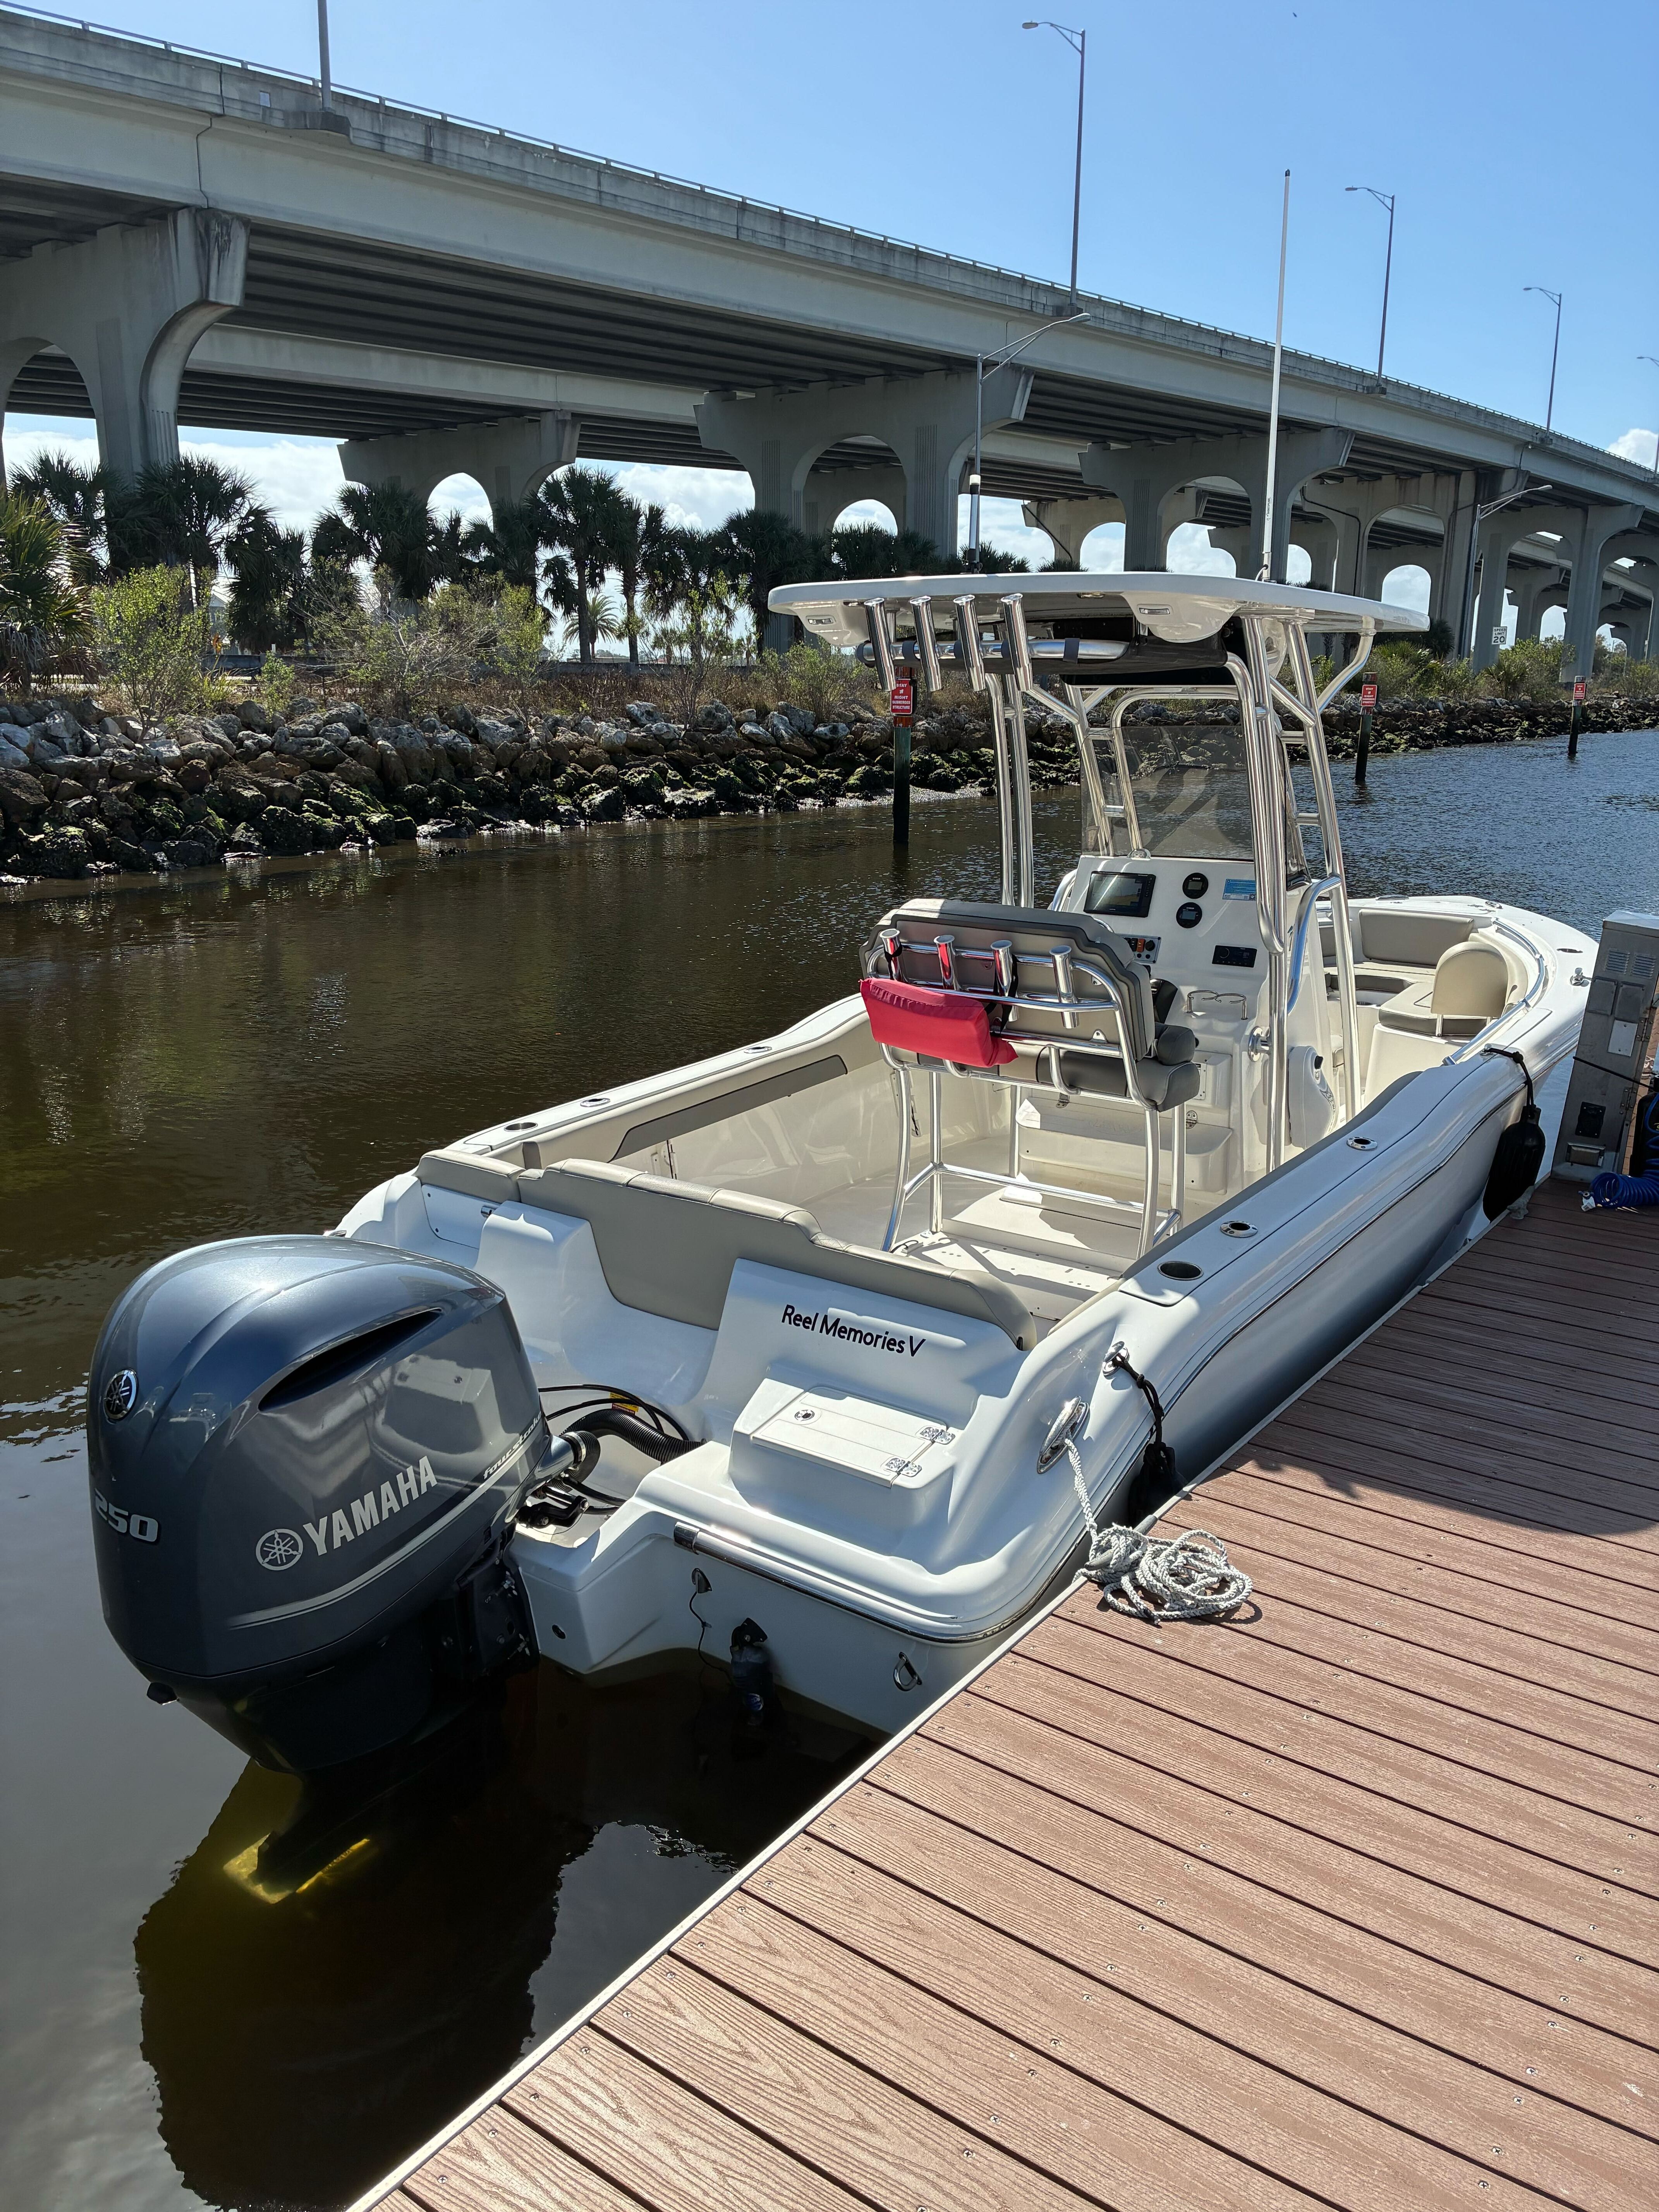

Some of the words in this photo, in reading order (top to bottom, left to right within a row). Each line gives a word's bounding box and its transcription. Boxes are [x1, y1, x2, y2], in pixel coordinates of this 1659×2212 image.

[781, 1304, 819, 1331] Reel
[819, 1314, 906, 1354] Memories
[909, 1335, 927, 1357] V
[94, 1487, 158, 1542] 250
[302, 1455, 438, 1556] YAMAHA
